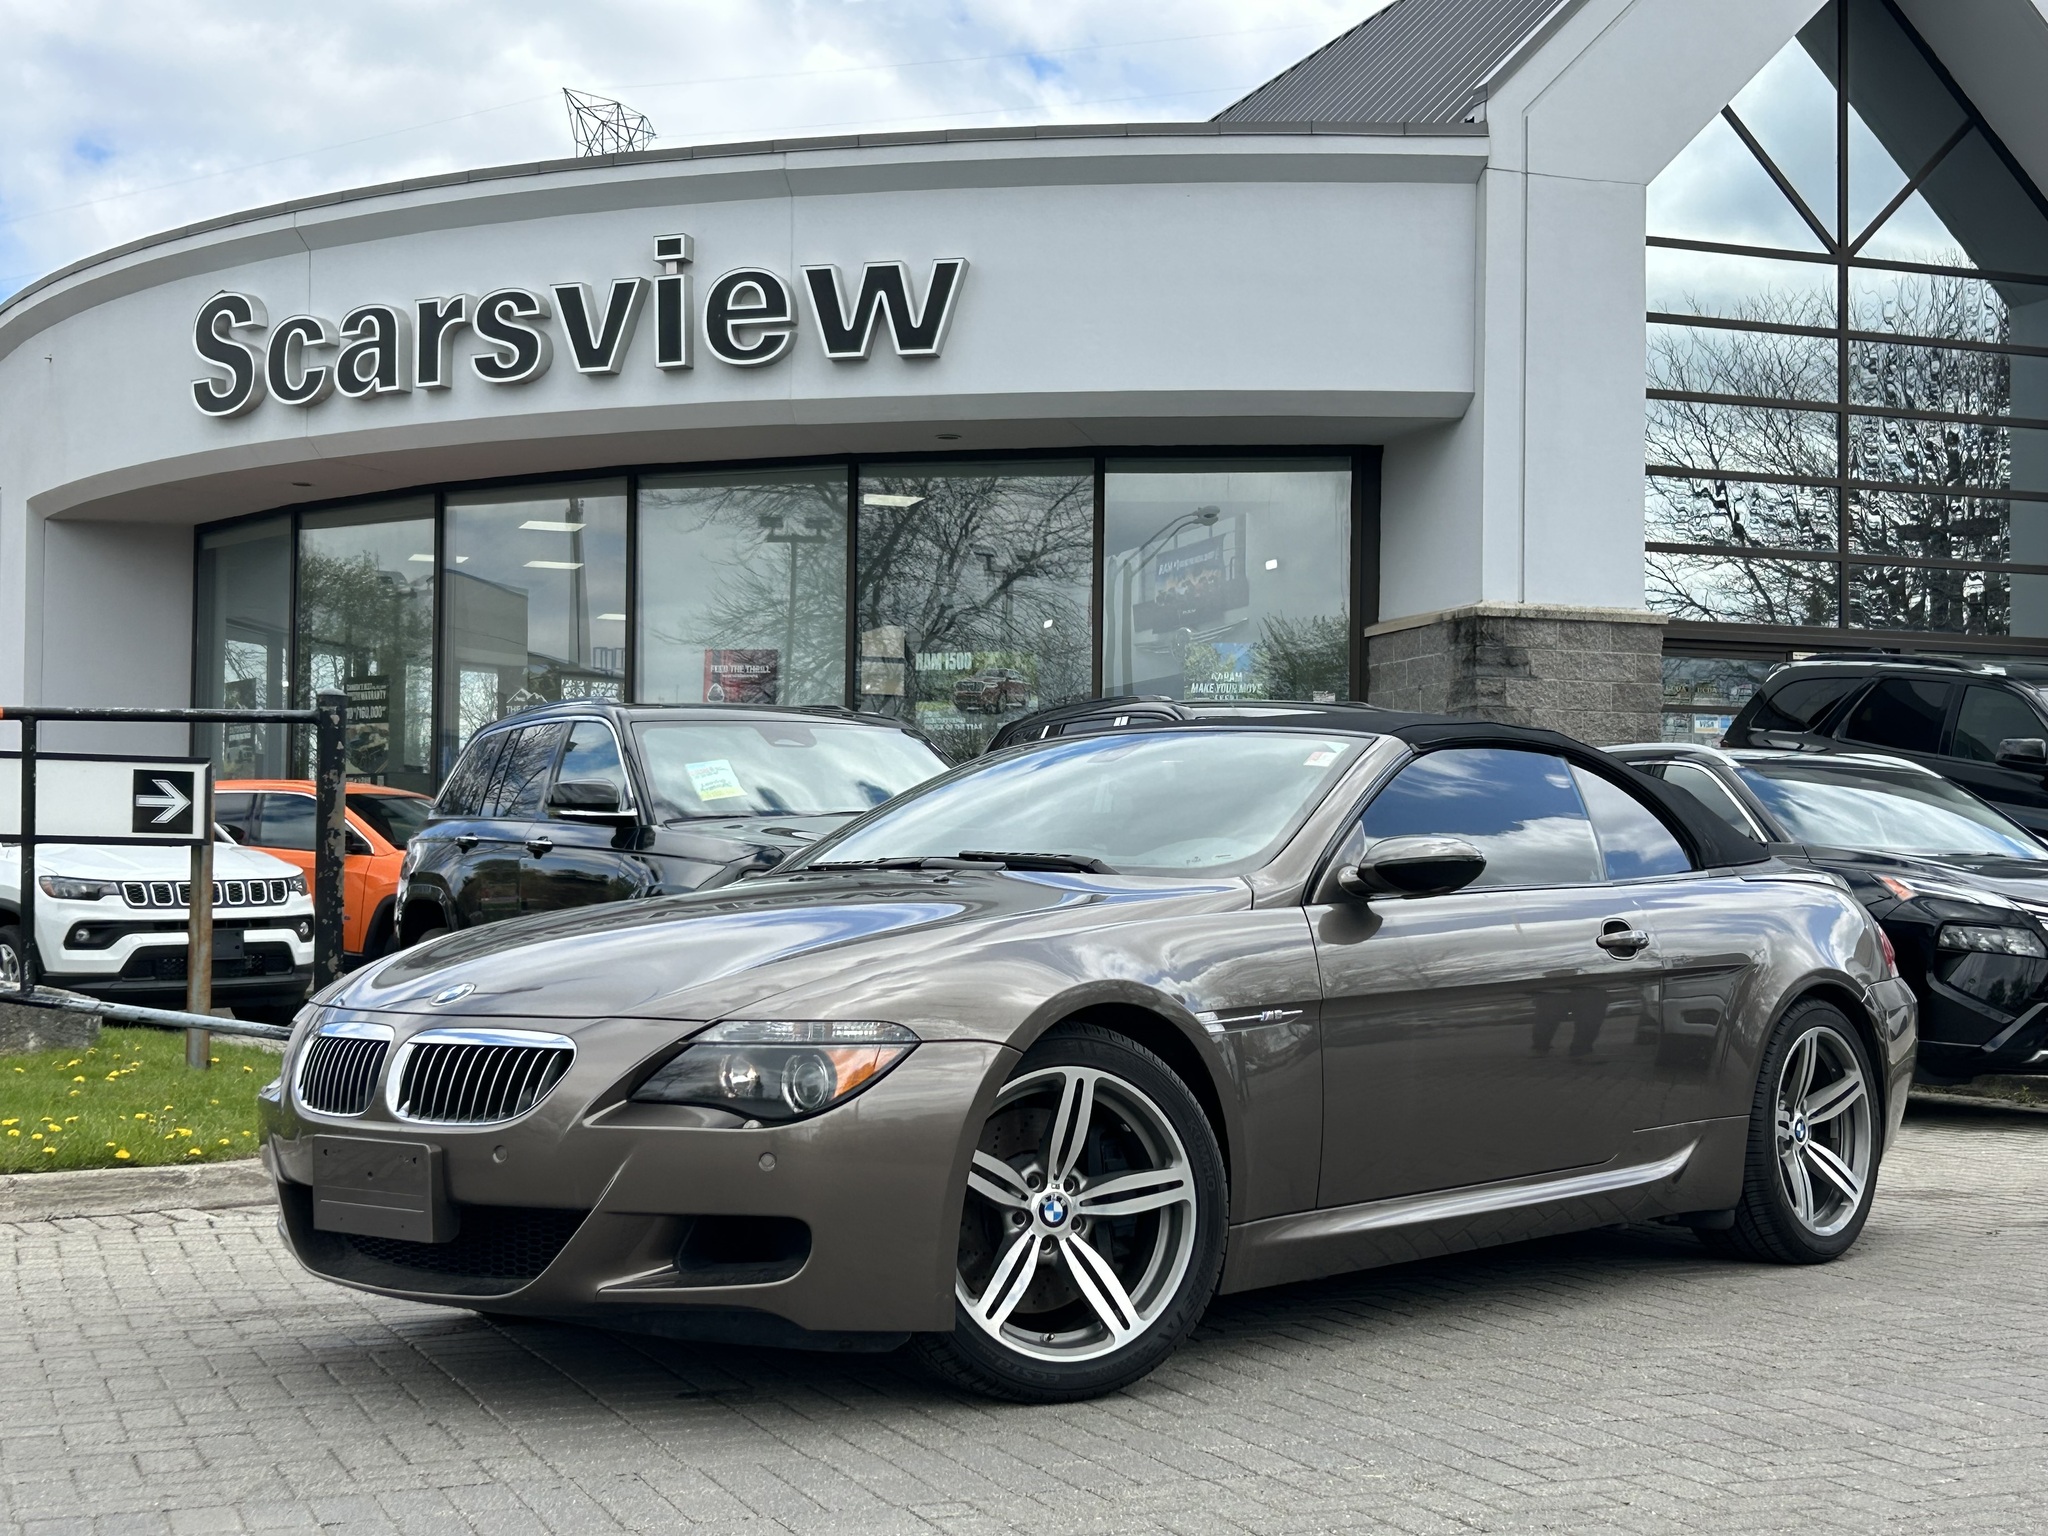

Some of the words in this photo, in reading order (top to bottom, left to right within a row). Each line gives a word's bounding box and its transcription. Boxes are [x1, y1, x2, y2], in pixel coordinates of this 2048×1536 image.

[191, 233, 968, 418] Scarsview
[915, 652, 942, 670] RAM
[944, 652, 972, 670] 1500
[730, 664, 744, 673] THE
[1224, 672, 1243, 682] RAM
[1191, 683, 1215, 693] MAKE
[1216, 683, 1237, 693] YOUR
[1238, 683, 1263, 693] MOVE
